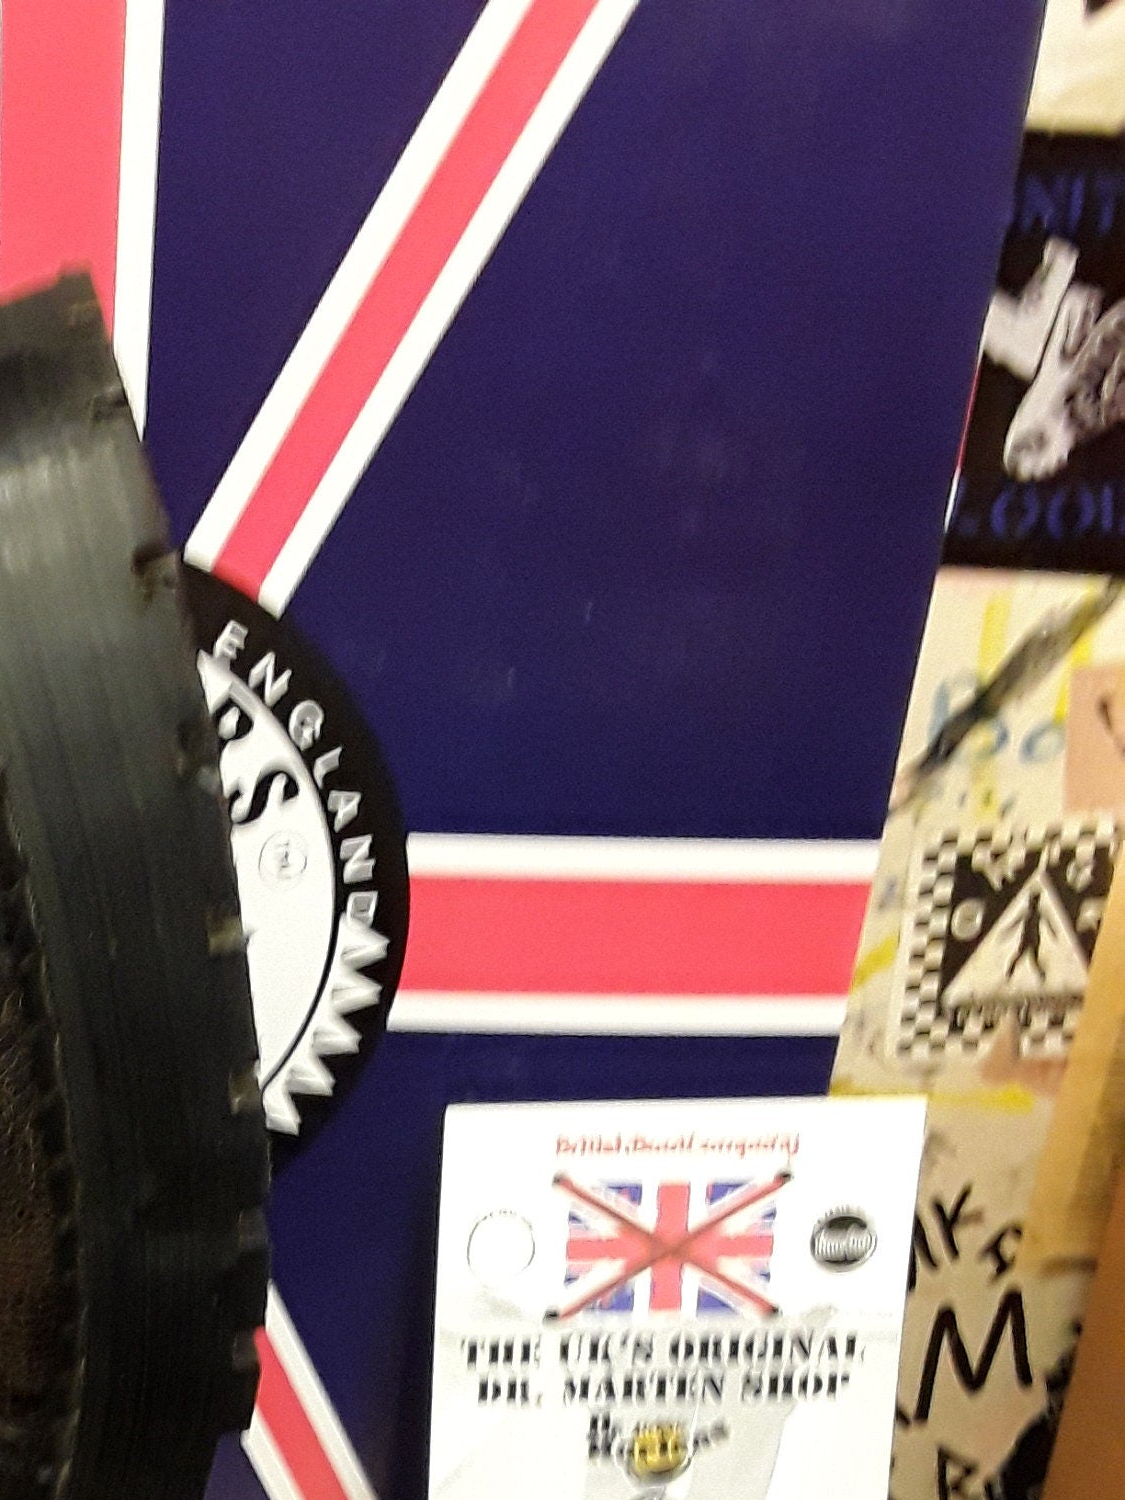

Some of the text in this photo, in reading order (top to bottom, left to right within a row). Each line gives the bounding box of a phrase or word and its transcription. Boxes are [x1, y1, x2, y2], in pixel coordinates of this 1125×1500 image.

[211, 619, 378, 929] ENGLAND
[460, 1333, 542, 1370] THE
[668, 1328, 867, 1366] ORIGINAL
[562, 1371, 726, 1406] MARTEN
[741, 1369, 852, 1403] SHOP
